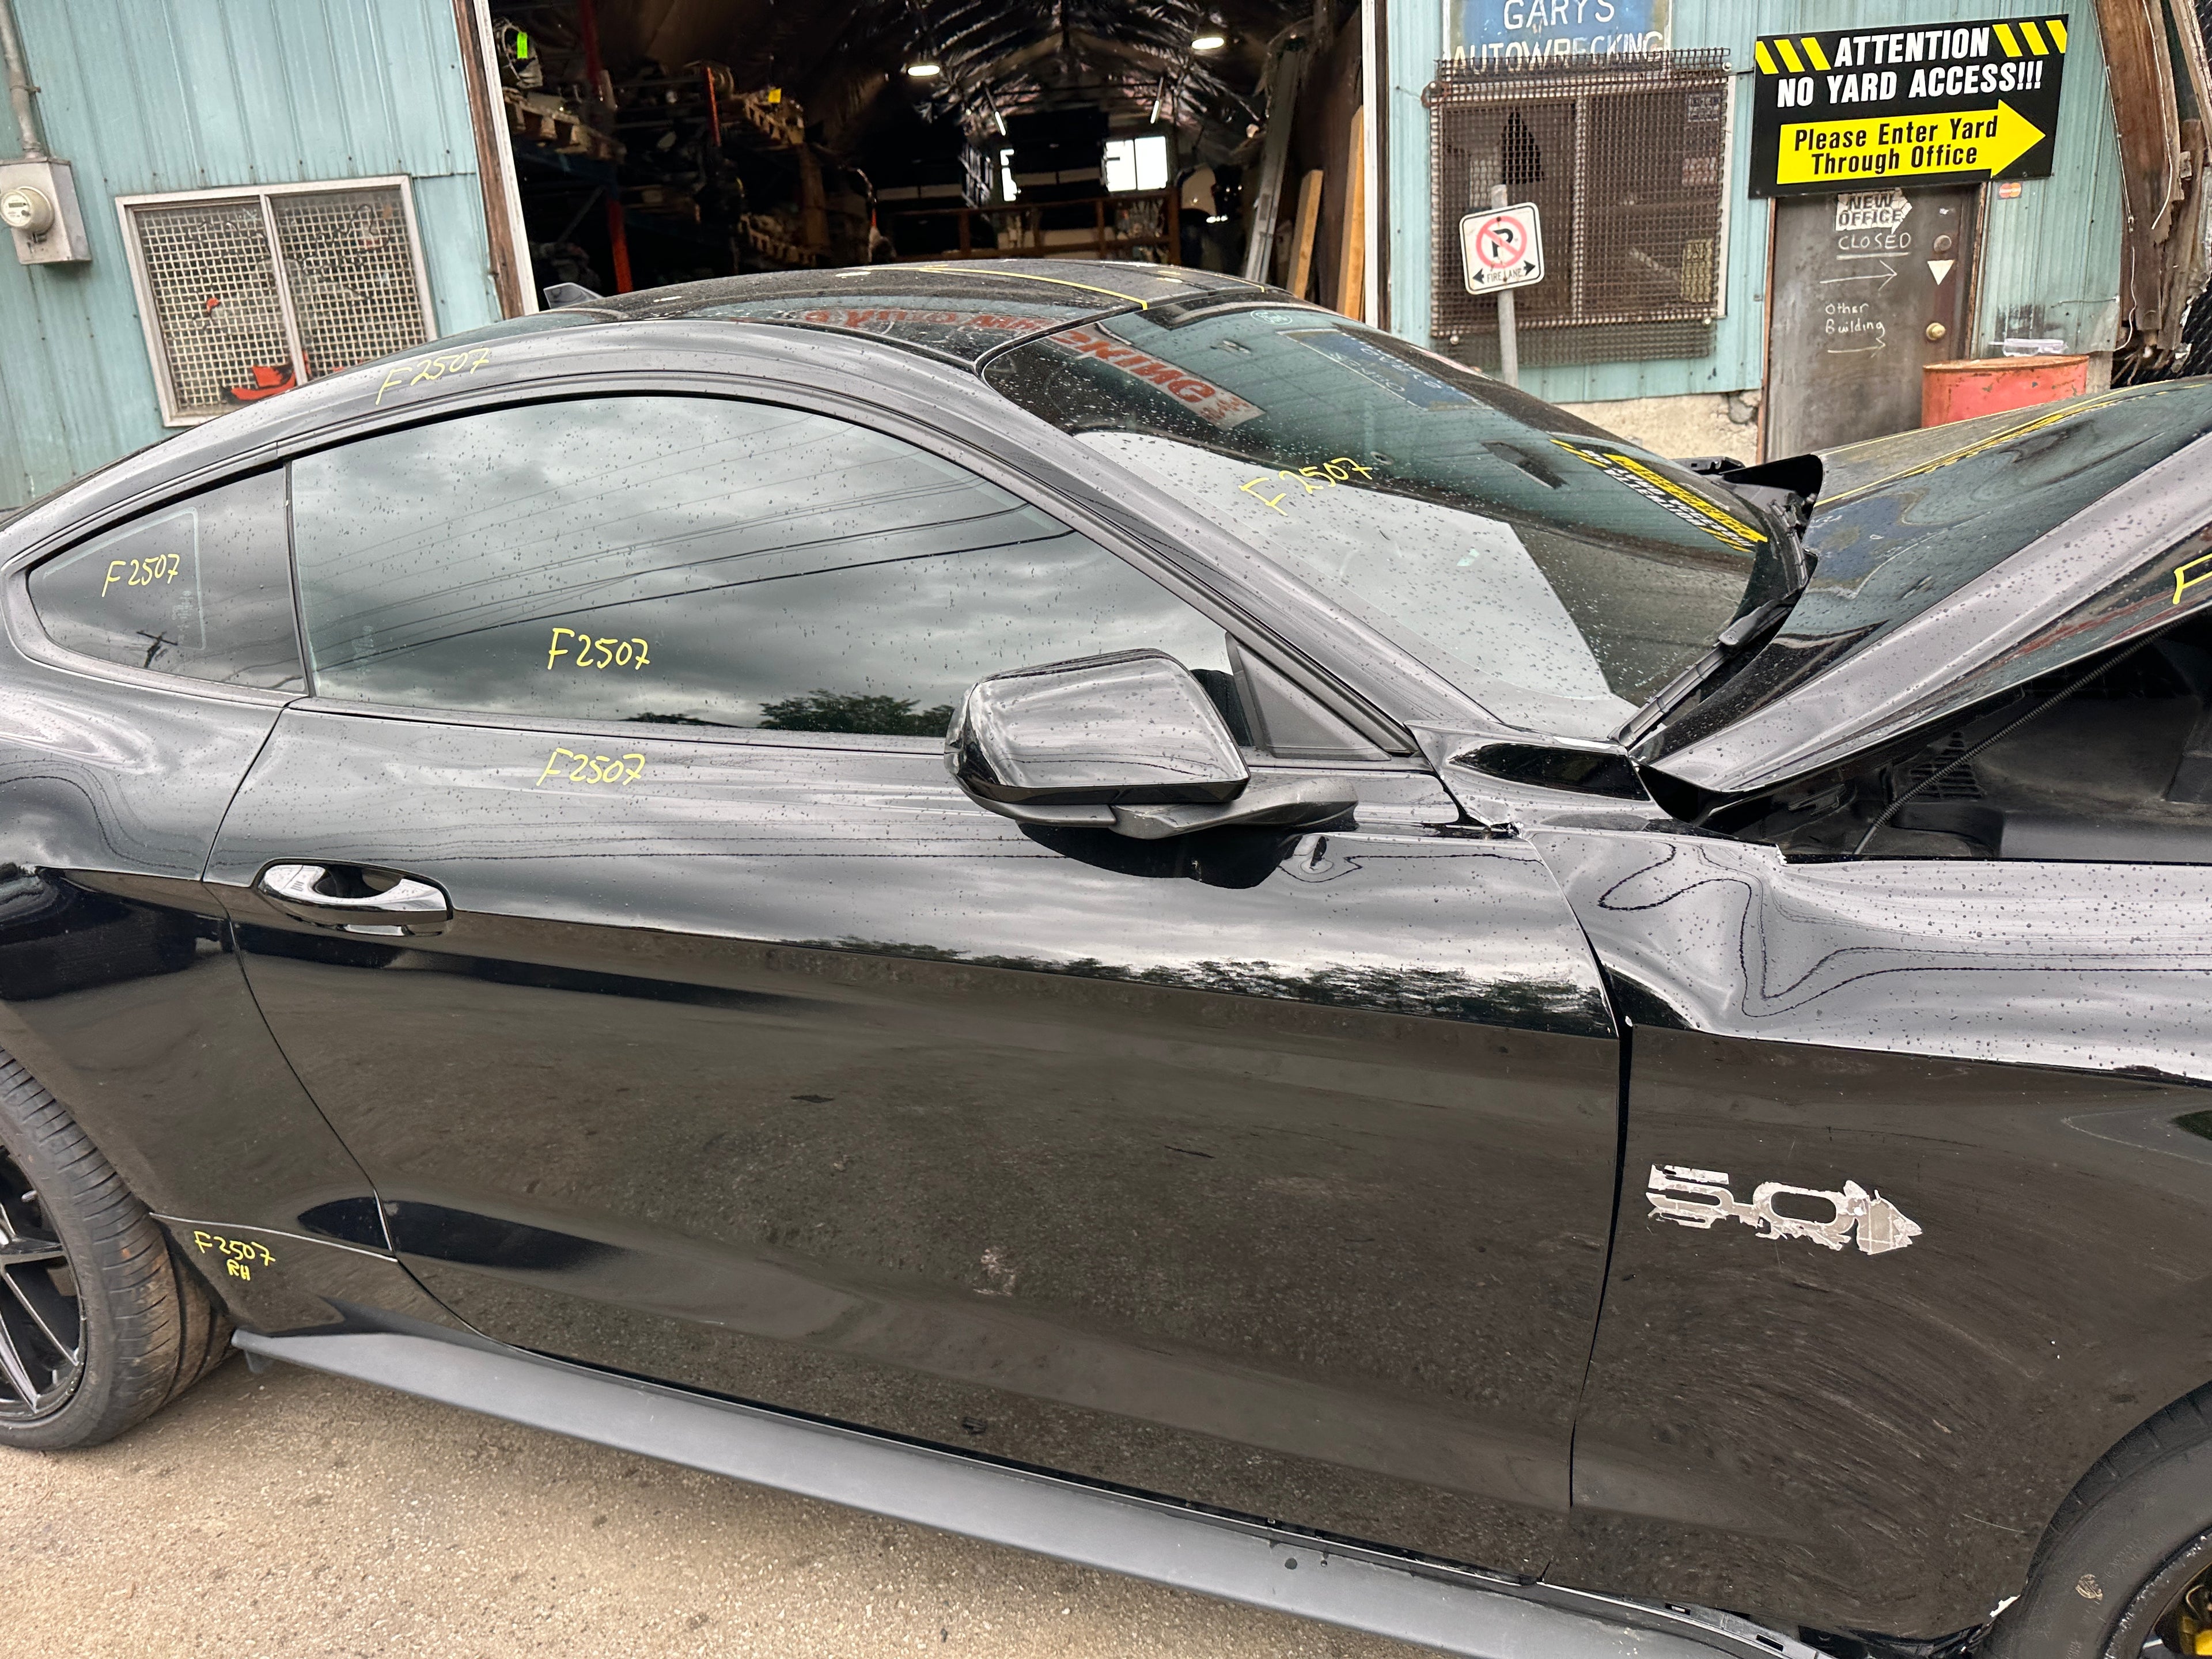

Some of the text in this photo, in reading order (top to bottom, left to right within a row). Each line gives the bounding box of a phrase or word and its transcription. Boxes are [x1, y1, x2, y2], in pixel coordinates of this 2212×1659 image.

[1834, 27, 1990, 67] ATTENTION
[1777, 60, 2043, 108] NO YARD ACCESS!!!
[1795, 115, 1998, 151] Please Enter Yard
[1811, 144, 1978, 175] Through Office
[1838, 210, 1902, 226] OFFICE
[1847, 194, 1892, 210] NEW
[1838, 232, 1911, 250] CLOSED
[1487, 271, 1503, 282] FIRE
[1825, 302, 1869, 315] Other
[1825, 317, 1885, 339] Building
[376, 347, 490, 406] F2507
[1238, 457, 1373, 517] F2507
[102, 554, 180, 597] F2507
[548, 627, 650, 670] F2507
[536, 747, 646, 786] F2507
[194, 1230, 276, 1267] F2507
[226, 1259, 251, 1281] RH
